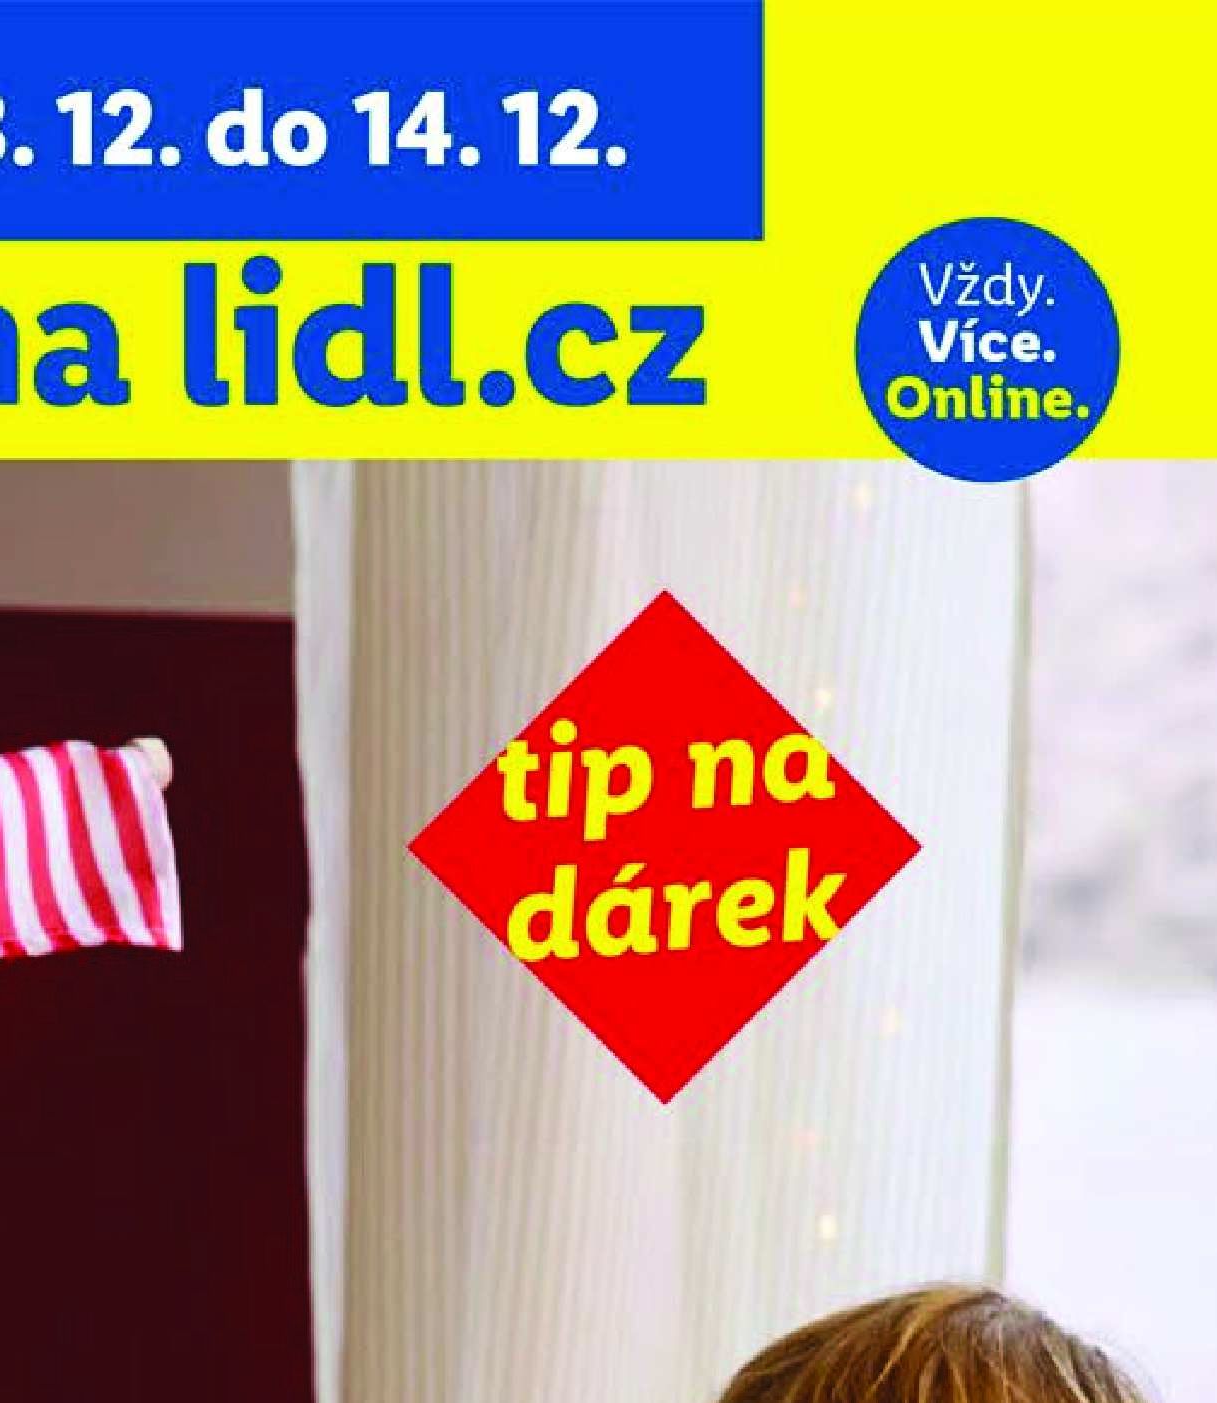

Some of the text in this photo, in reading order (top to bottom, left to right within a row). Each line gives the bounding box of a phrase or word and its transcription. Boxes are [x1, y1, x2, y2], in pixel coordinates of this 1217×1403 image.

[56, 88, 180, 167] 12.
[207, 88, 327, 167] do
[354, 91, 479, 167] 14.
[503, 88, 626, 167] 12.
[919, 261, 1056, 310] Vždy.
[186, 257, 703, 405] lidl.cz
[918, 314, 1055, 363] Více.
[886, 373, 1089, 421] Online.
[499, 721, 836, 839] tip na
[505, 850, 847, 963] dárek
